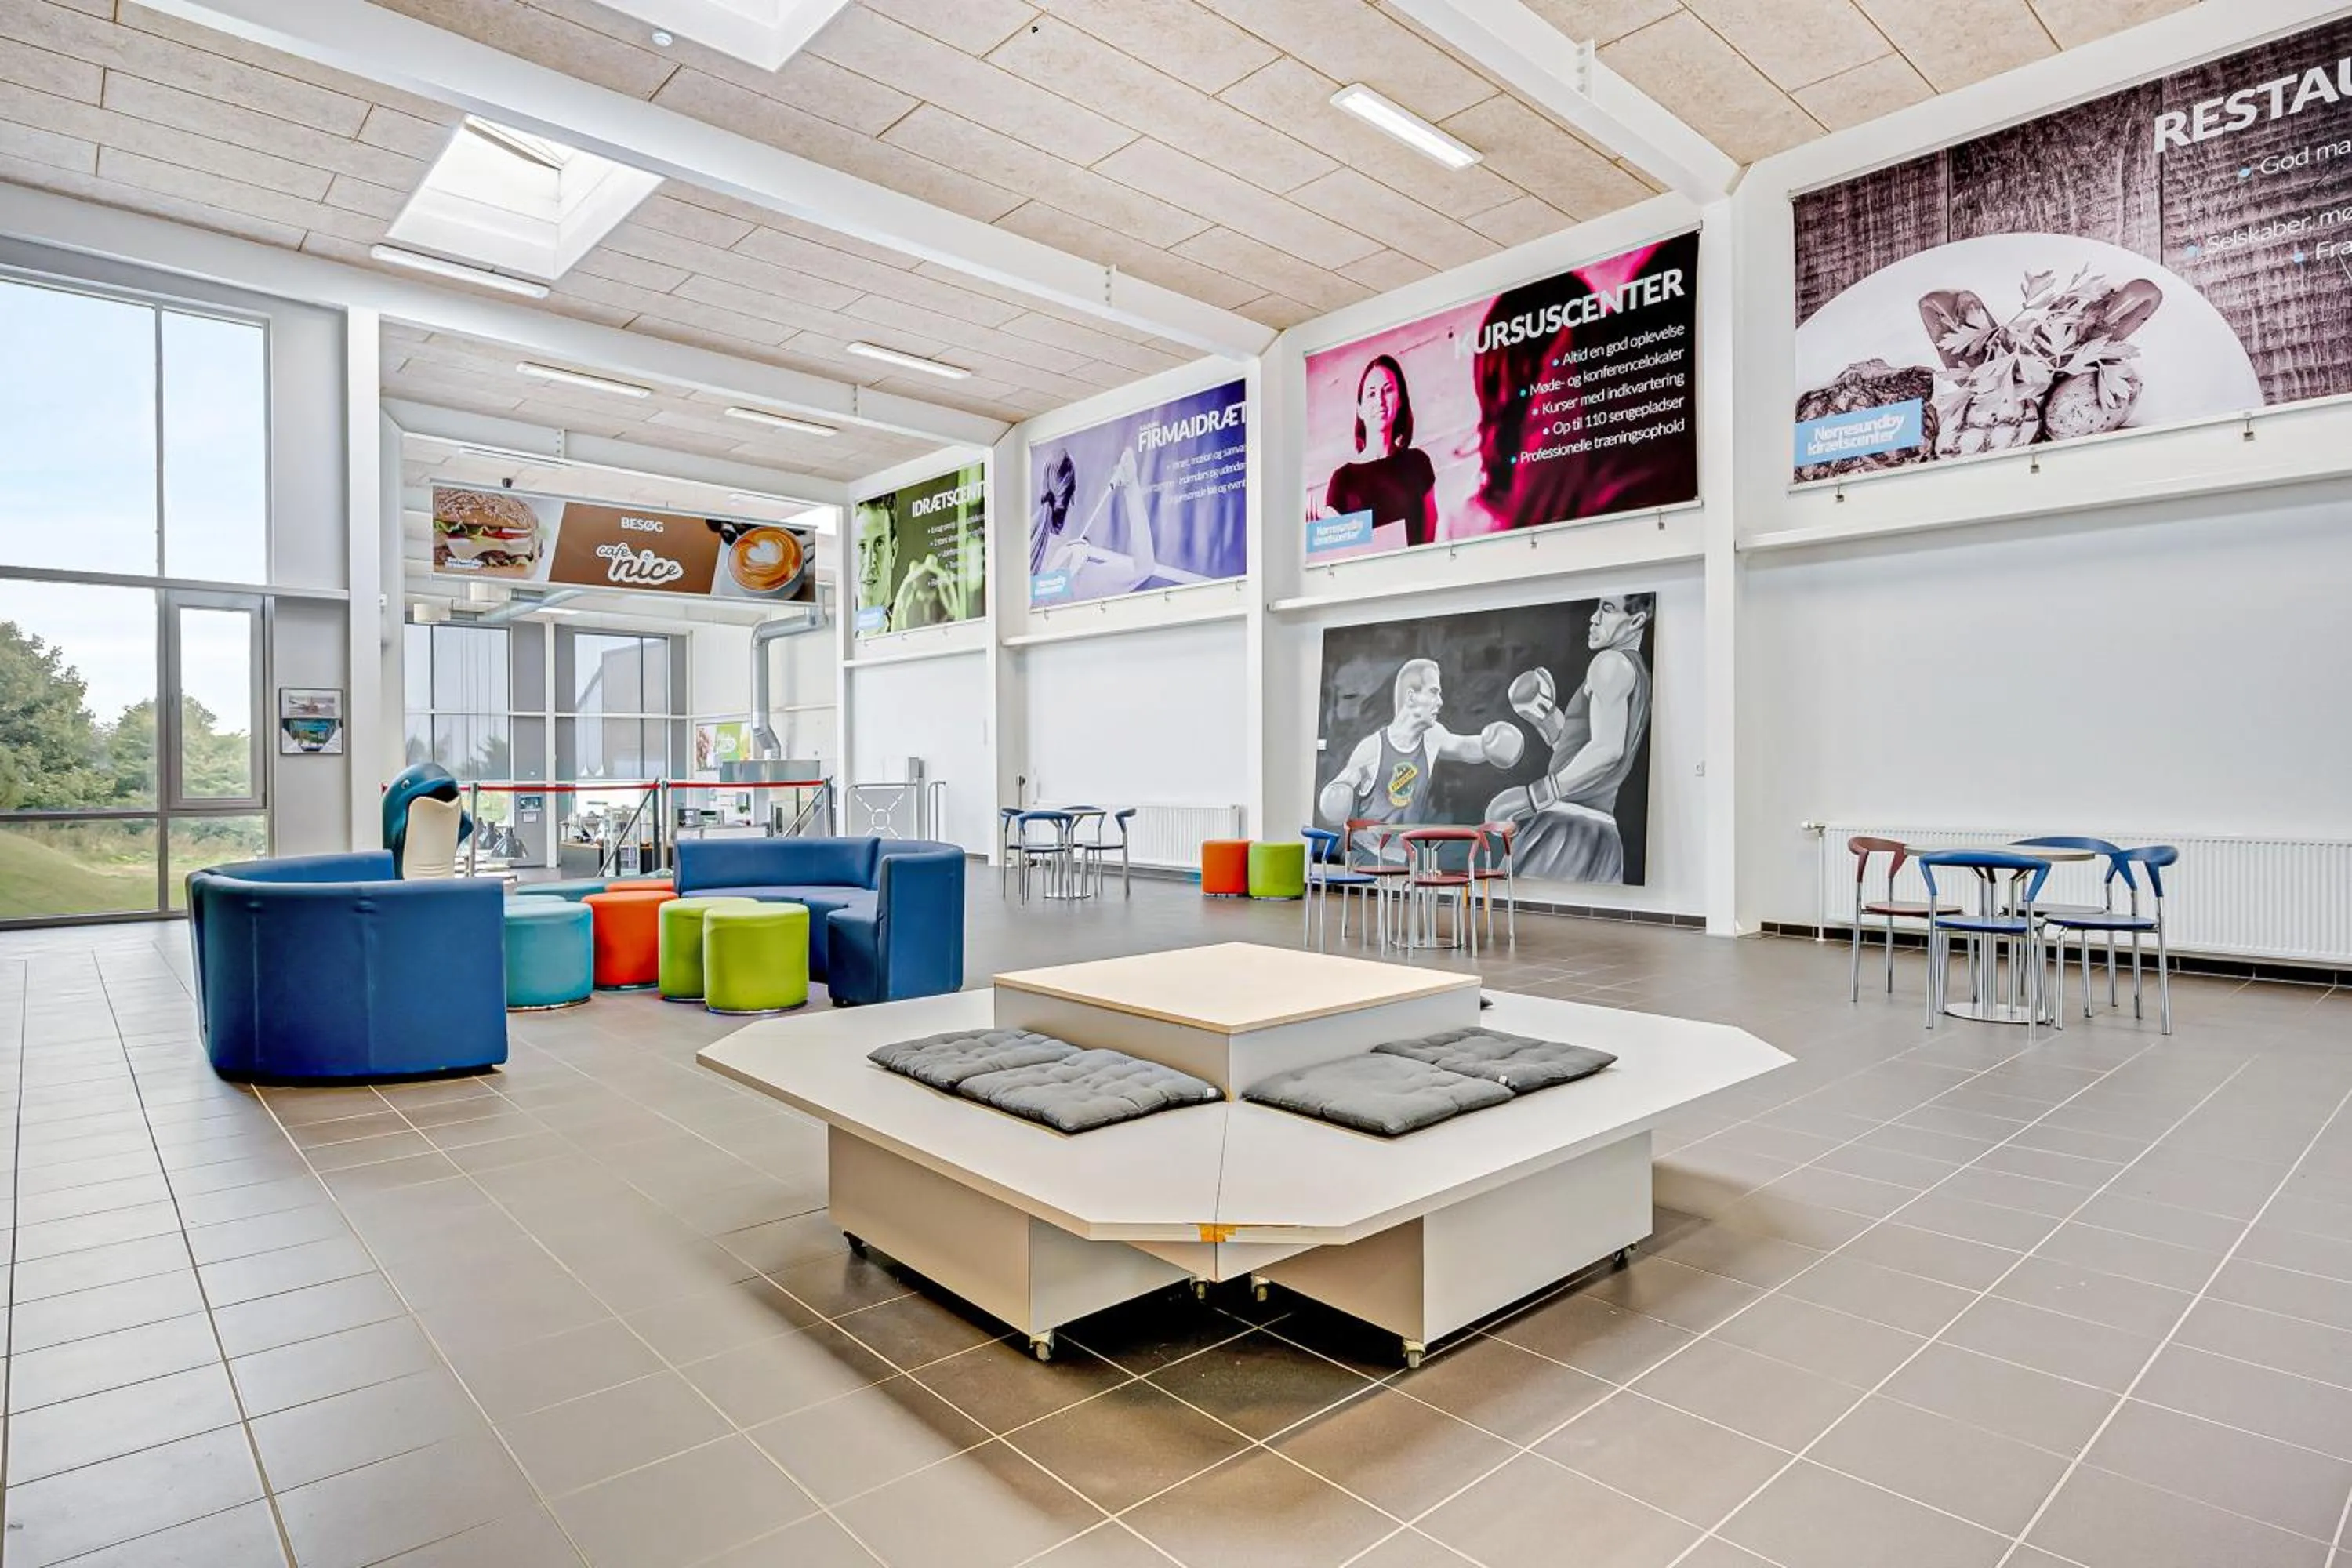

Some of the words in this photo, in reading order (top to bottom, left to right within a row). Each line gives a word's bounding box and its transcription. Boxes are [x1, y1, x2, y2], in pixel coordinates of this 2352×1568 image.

[2260, 147, 2309, 175] God
[2207, 215, 2311, 252] Selskaber,
[1454, 268, 1686, 359] KURSUSCENTER
[1562, 347, 1588, 366] Altid
[1590, 347, 1605, 358] en
[1606, 336, 1628, 357] god
[1630, 324, 1685, 349] oplevelse
[1530, 379, 1566, 396] Møde-
[1567, 376, 1582, 388] og
[1584, 348, 1685, 383] konferencelokaler
[1542, 397, 1580, 415] Kurser
[1581, 389, 1605, 405] med
[1607, 372, 1685, 400] indkvartering
[1138, 401, 1246, 452] FIRMAIDRÆT
[1552, 421, 1571, 436] Op
[1572, 417, 1583, 430] til
[1585, 412, 1607, 428] 110
[1609, 396, 1685, 422] sengepladser
[1520, 438, 1592, 463] Professionelle
[1595, 418, 1685, 448] træningsophold
[621, 517, 664, 532] BESØG
[612, 551, 681, 581] nice
